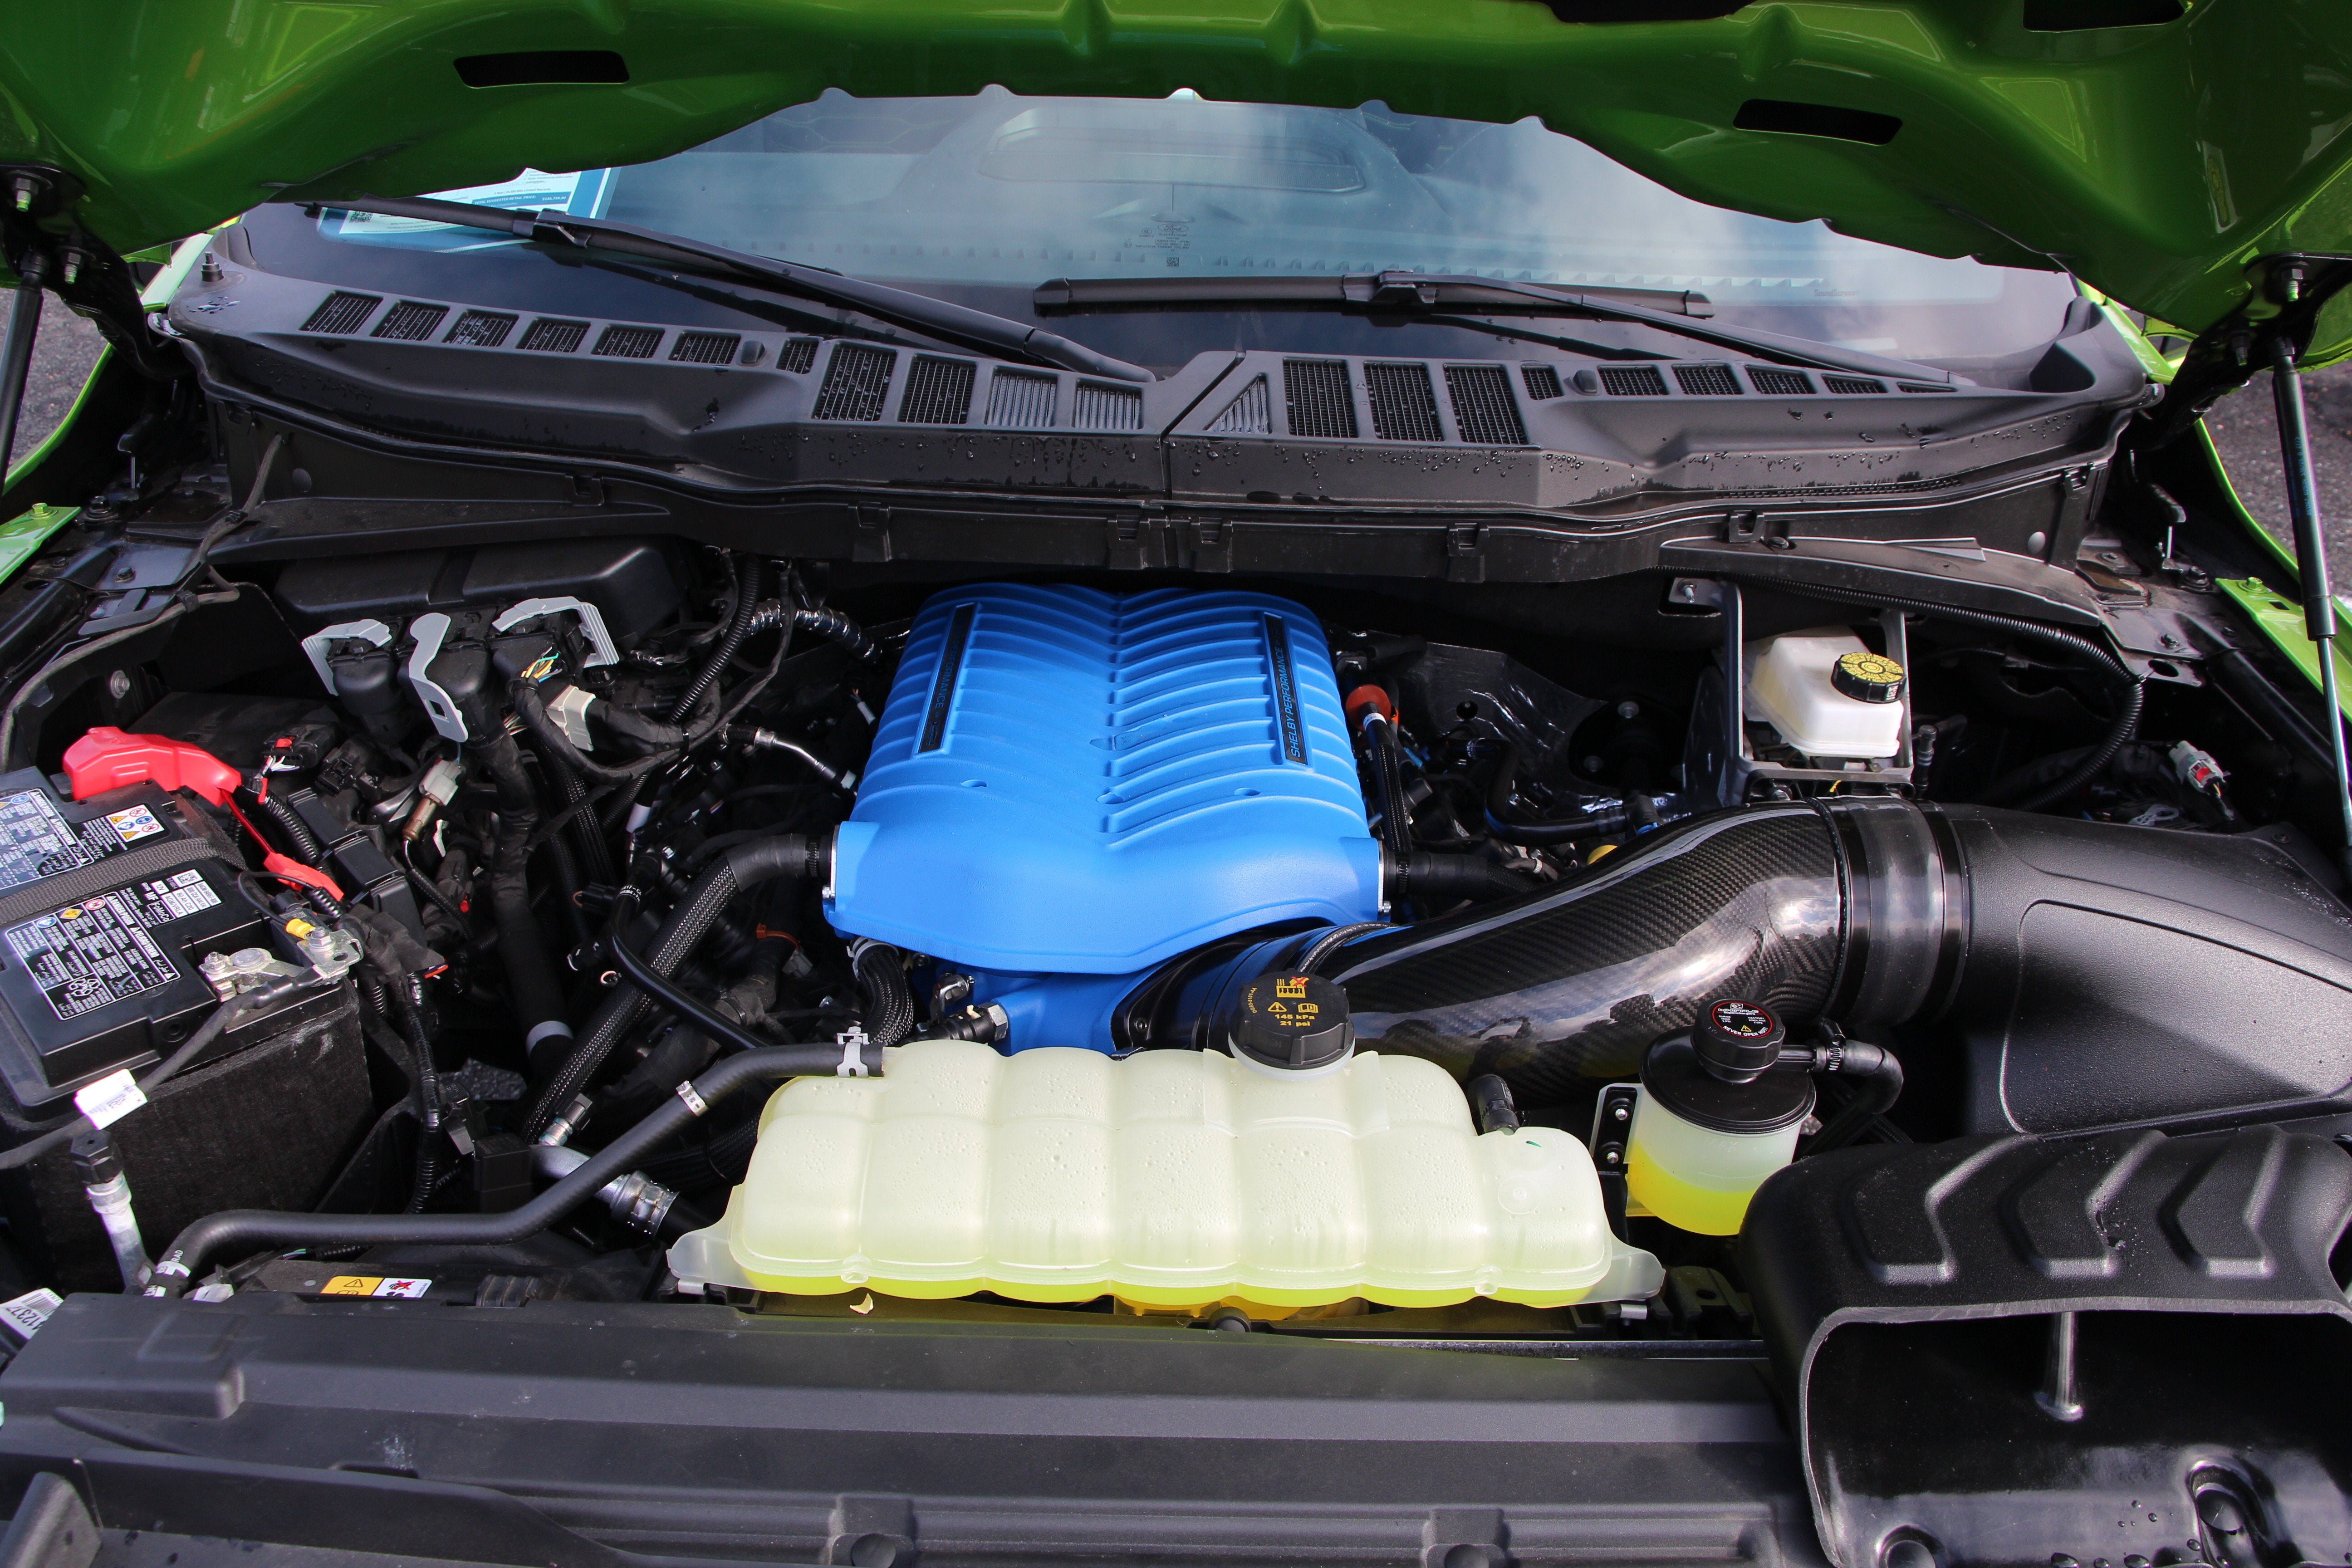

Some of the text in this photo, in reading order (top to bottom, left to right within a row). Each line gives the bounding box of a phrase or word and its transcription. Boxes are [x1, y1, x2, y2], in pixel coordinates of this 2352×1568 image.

[935, 641, 959, 709] PERFORMANCE
[1275, 647, 1294, 715] PERFORMANCE
[1286, 715, 1300, 757] SHELBY
[144, 891, 159, 902] MF
[164, 895, 183, 916] AGM/VRLA
[184, 902, 194, 910] C20
[151, 902, 171, 922] FoMoCo
[46, 952, 69, 980] CONTRA DERRAMES
[1723, 1025, 1742, 1035] NEVER
[1703, 1137, 1739, 1152] MAX
[171, 1250, 183, 1263] RAD
